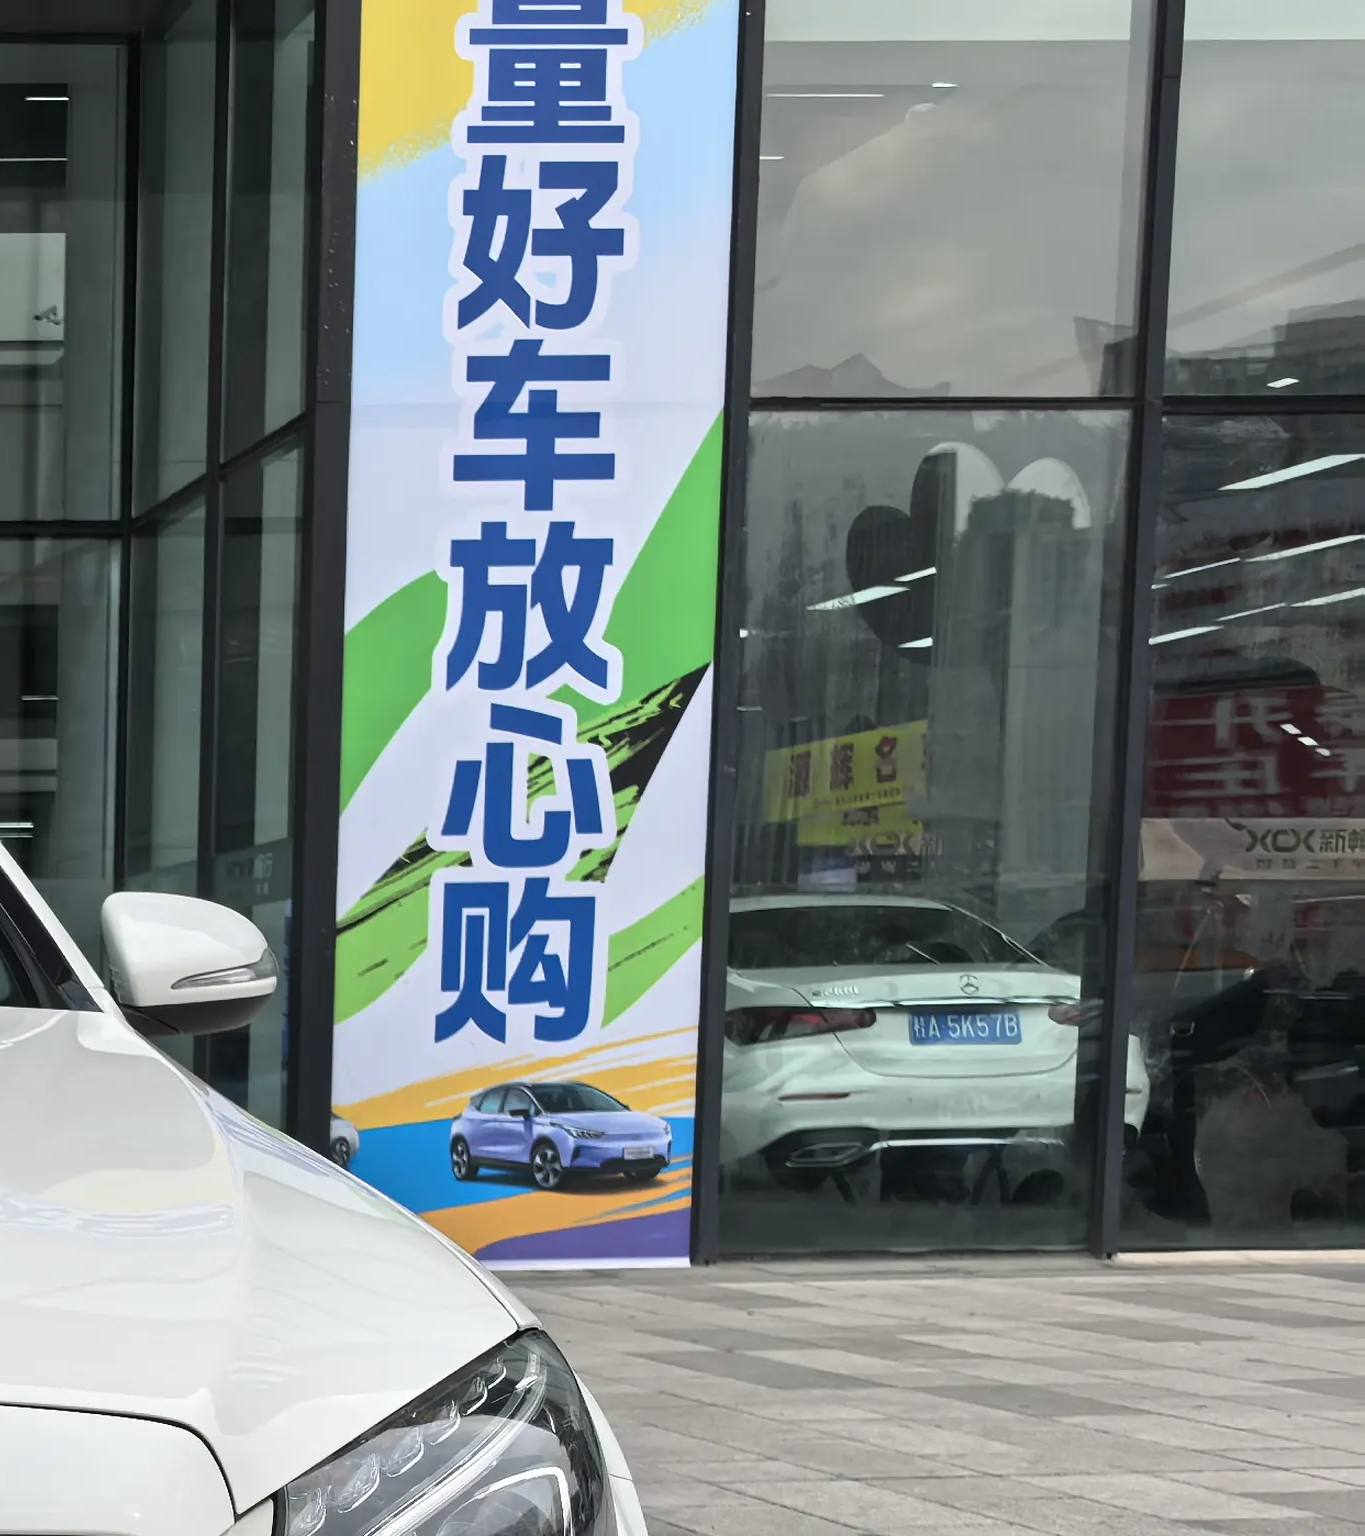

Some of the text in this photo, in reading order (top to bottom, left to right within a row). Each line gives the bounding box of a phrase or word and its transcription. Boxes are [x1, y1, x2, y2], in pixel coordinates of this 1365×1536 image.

[434, 0, 627, 1042] 量好车放心购
